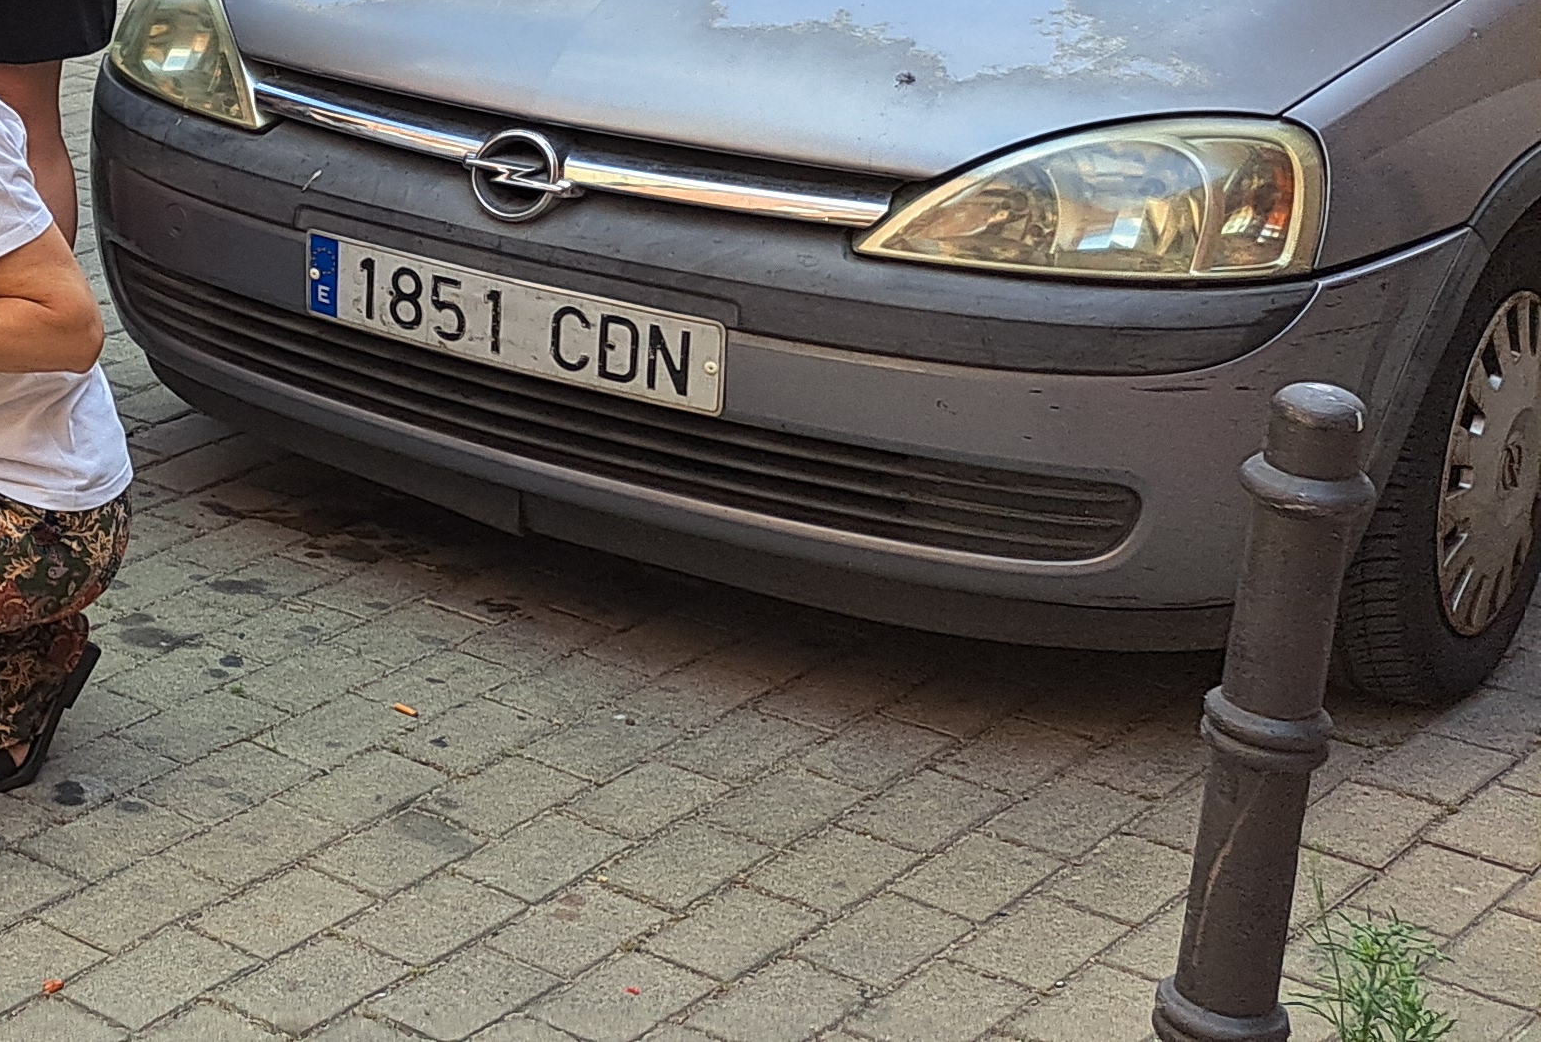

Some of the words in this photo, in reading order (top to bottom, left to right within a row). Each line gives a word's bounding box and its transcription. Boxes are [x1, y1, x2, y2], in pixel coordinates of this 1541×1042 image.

[318, 284, 331, 305] E
[359, 257, 503, 355] 1851
[550, 305, 691, 397] CDN
